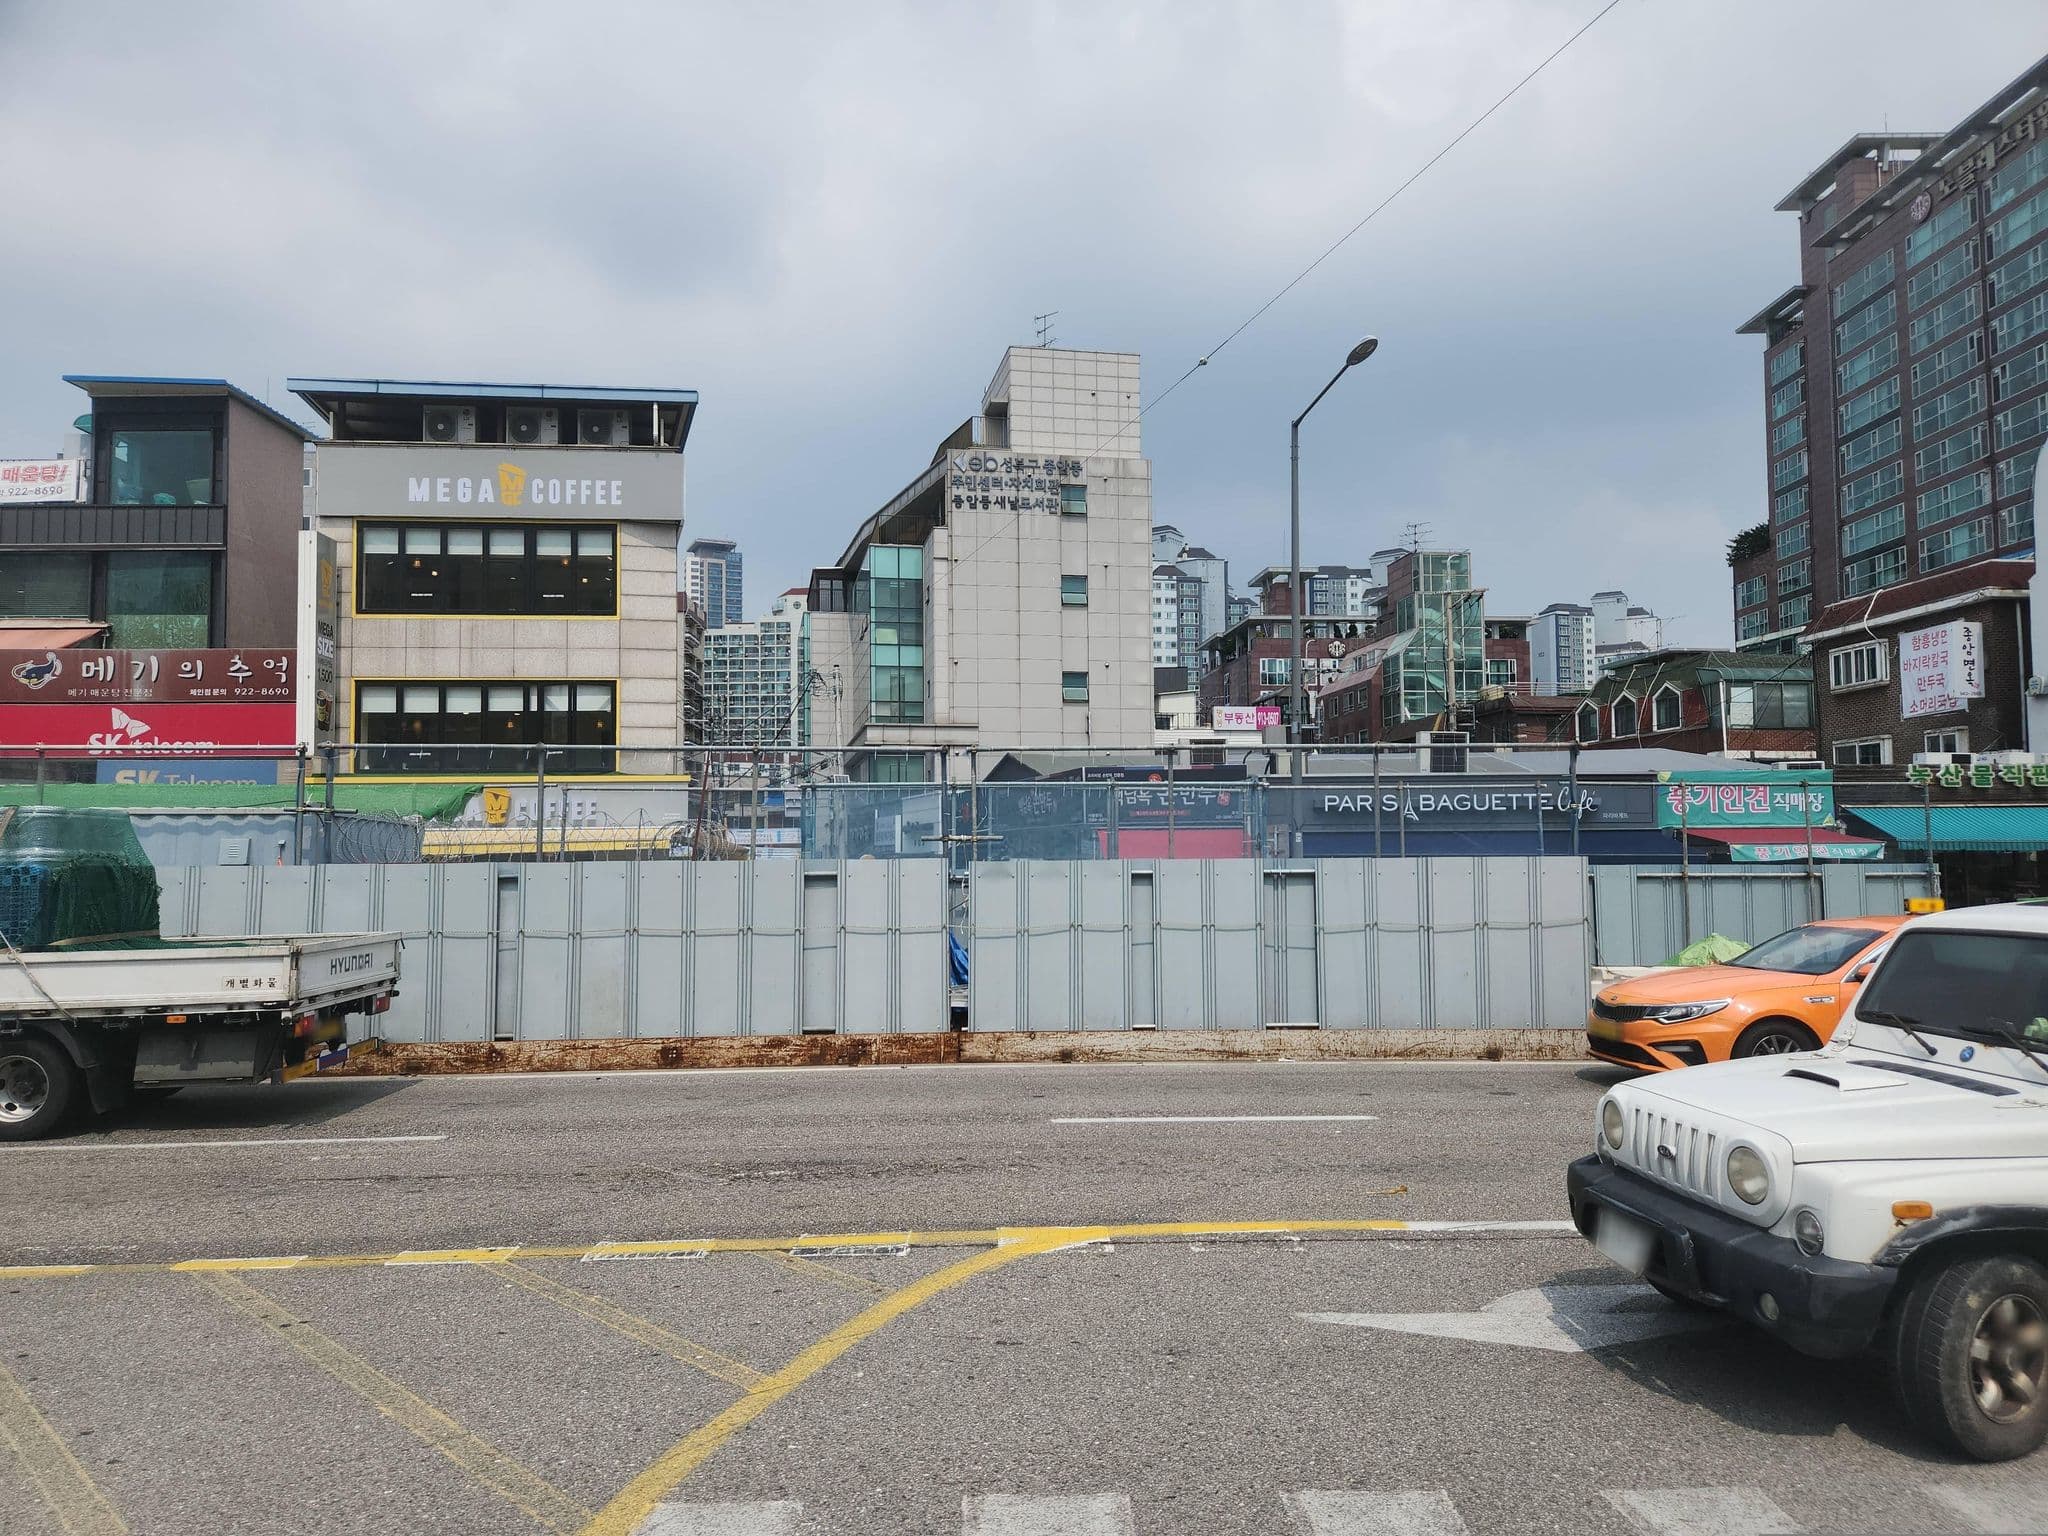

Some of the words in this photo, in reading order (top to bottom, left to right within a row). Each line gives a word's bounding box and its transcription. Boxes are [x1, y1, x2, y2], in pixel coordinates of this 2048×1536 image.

[1000, 457, 1040, 474] 성북구
[1043, 459, 1083, 477] 종암동
[8, 486, 63, 496] 922-8690
[408, 477, 495, 503] MEGA
[531, 478, 623, 505] COFFEE
[317, 636, 334, 659] SIZE
[233, 687, 290, 697] 922-8690
[1917, 672, 1945, 692] 만두국
[67, 687, 87, 697] 메기
[90, 687, 120, 698] 매운탕
[1224, 712, 1255, 725] 부동산
[88, 733, 124, 755] SK
[133, 736, 215, 754] telecom
[1324, 794, 1398, 812] PARS
[1419, 793, 1553, 811] BAGUETTE
[1558, 786, 1598, 819] Cfé
[1667, 784, 1770, 814] 풍기인견
[1773, 792, 1825, 812] 직매장
[330, 953, 374, 975] HYUNDAI
[225, 977, 279, 989] 개별화물
